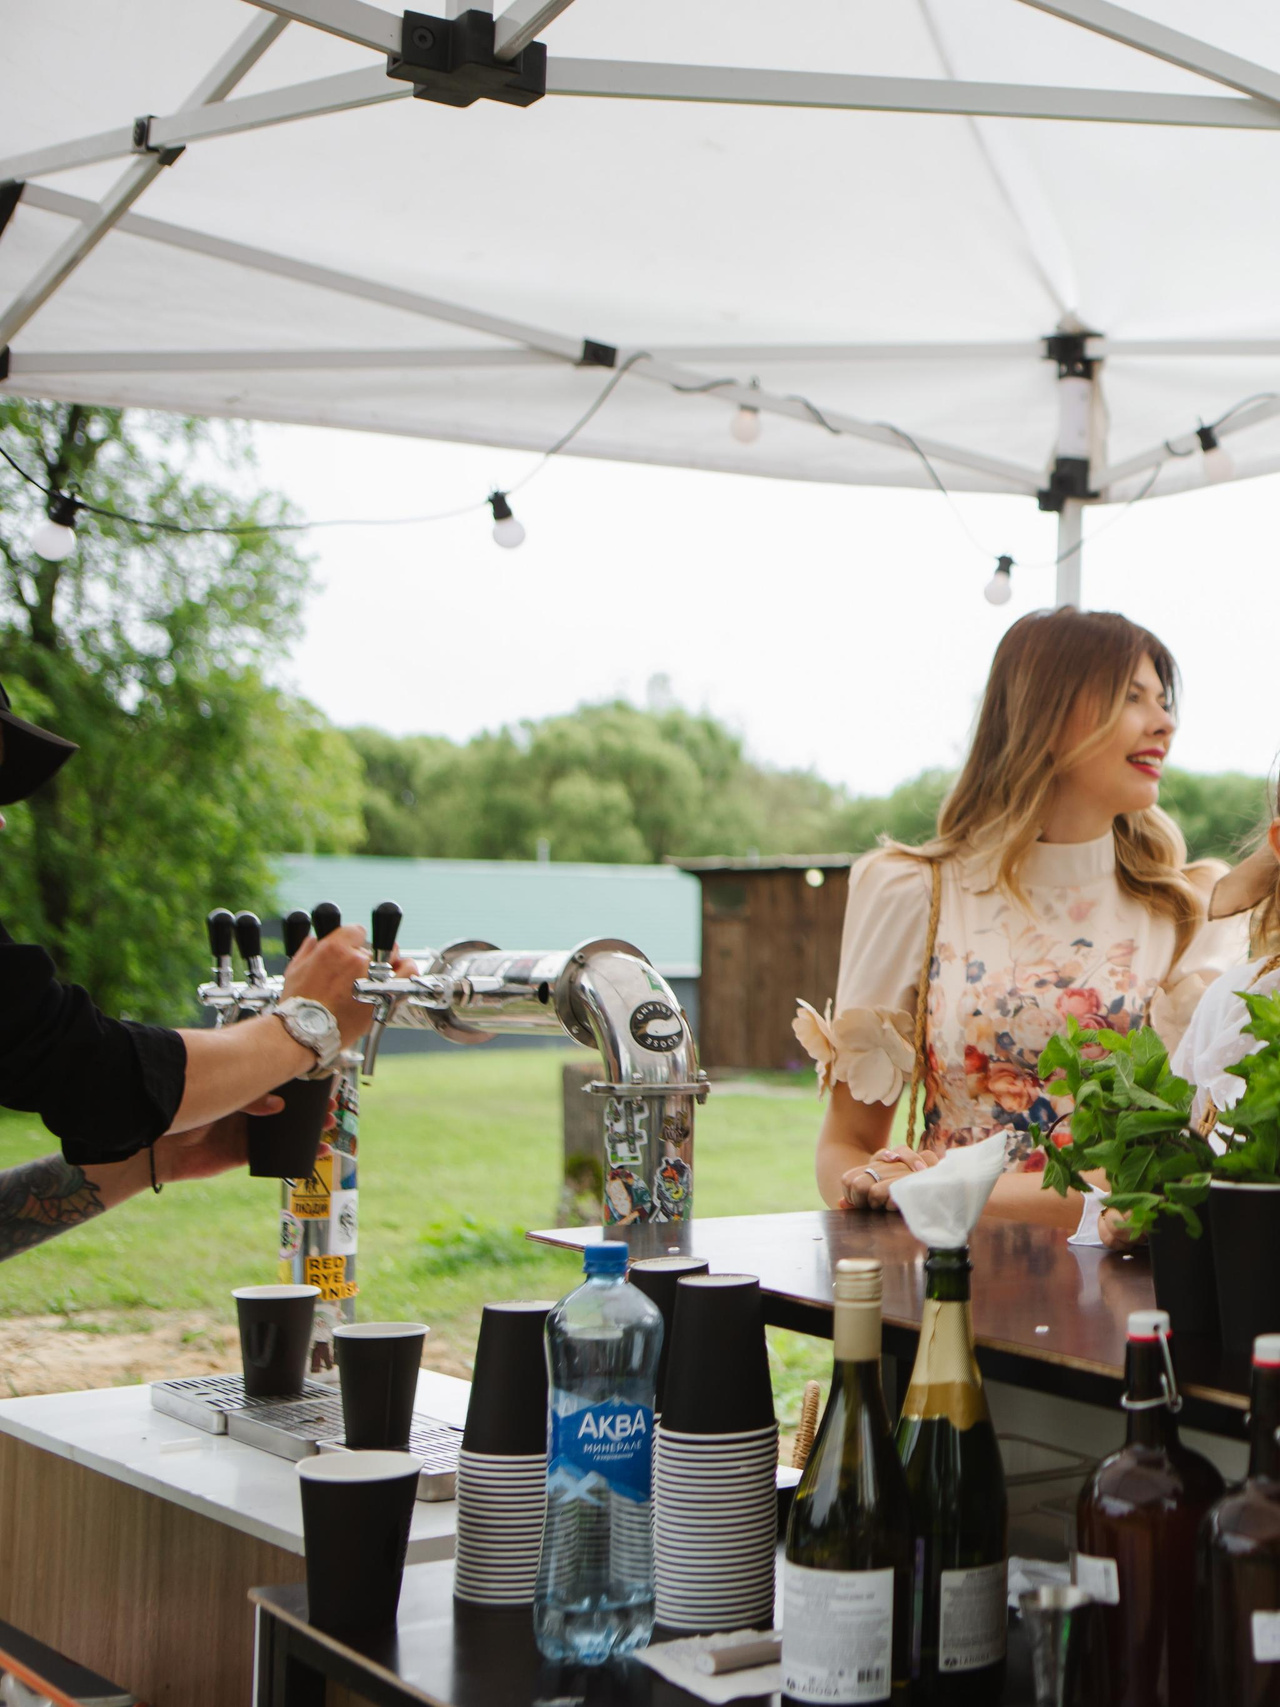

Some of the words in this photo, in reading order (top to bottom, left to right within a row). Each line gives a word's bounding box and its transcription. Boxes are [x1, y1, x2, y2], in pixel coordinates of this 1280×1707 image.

[645, 1035, 678, 1047] GOOSE
[309, 1256, 344, 1270] RED
[309, 1272, 343, 1285] RYE
[577, 1409, 646, 1441] АКВА
